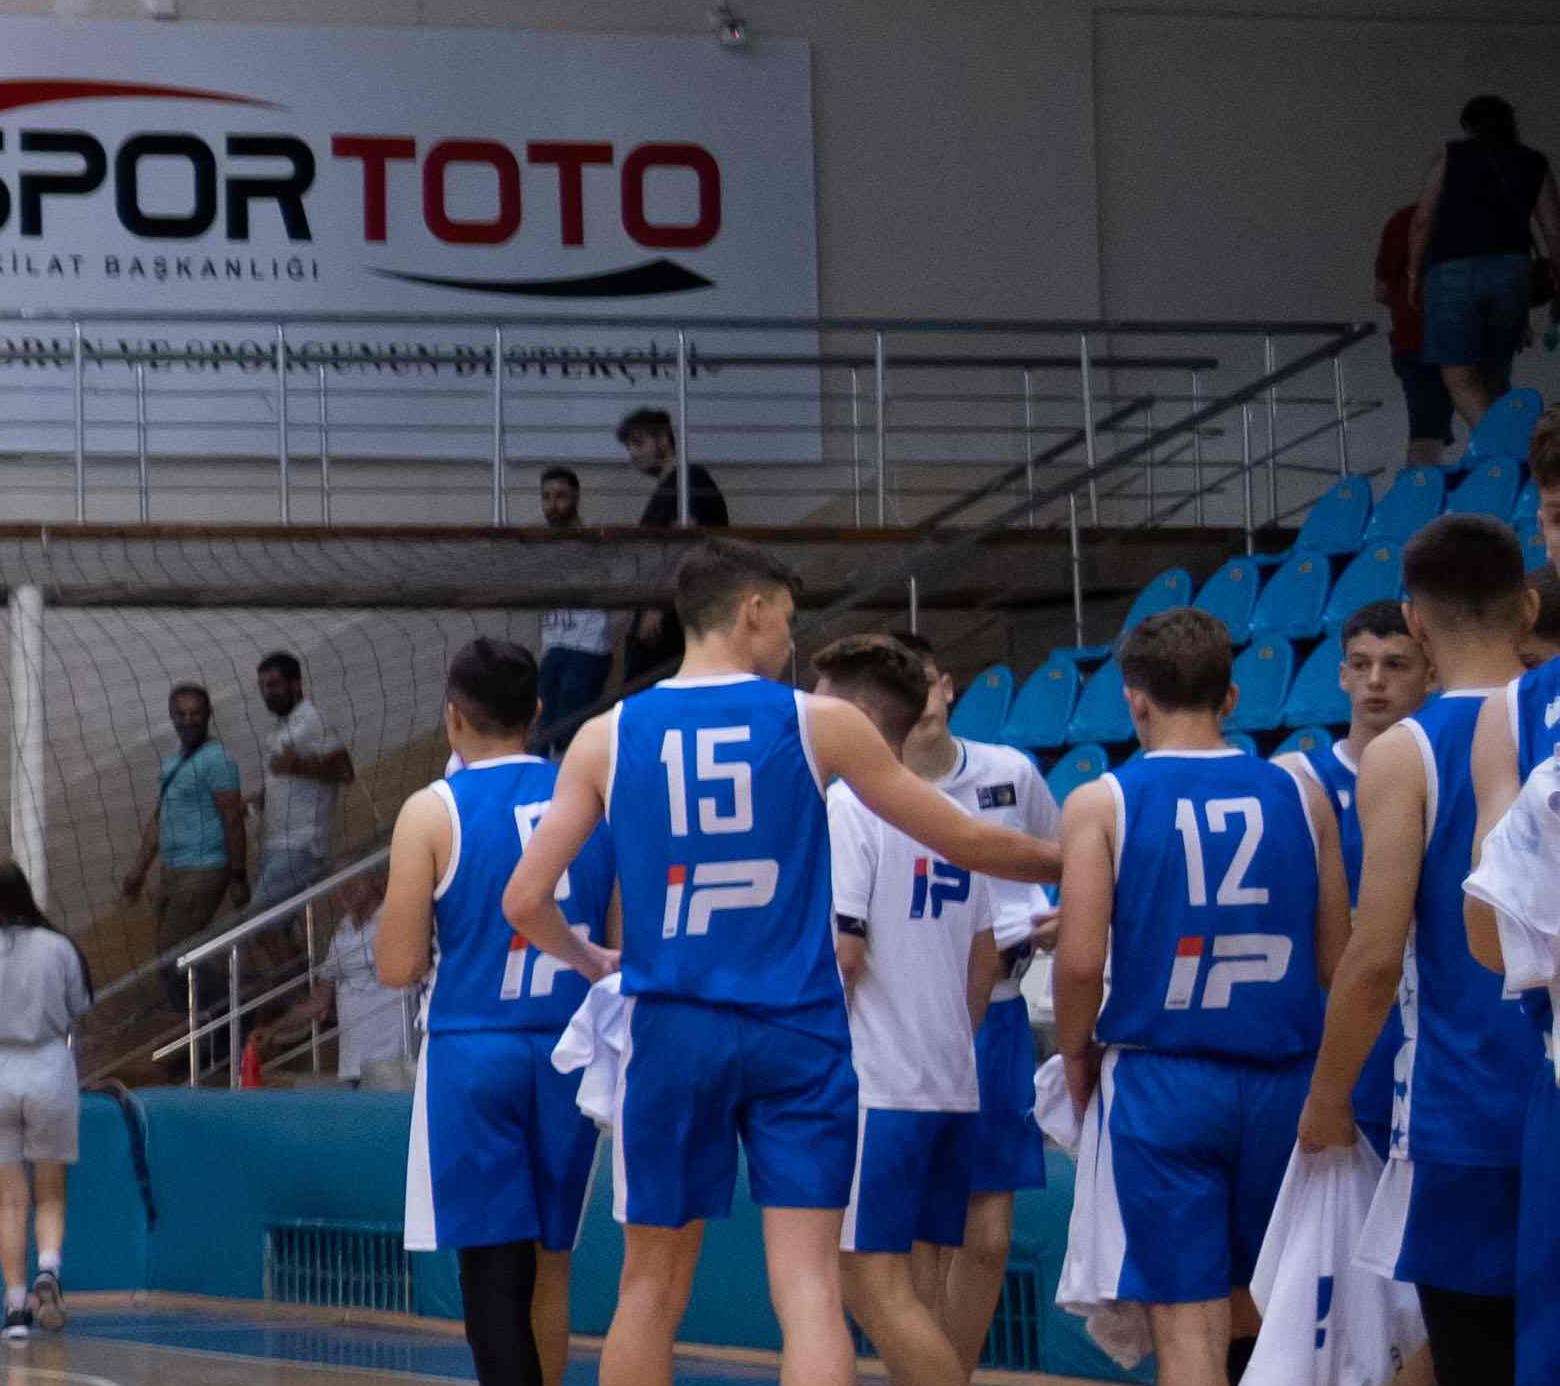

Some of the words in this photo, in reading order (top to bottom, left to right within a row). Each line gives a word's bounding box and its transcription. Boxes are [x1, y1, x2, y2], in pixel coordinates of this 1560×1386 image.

[330, 135, 722, 250] TOTO
[660, 725, 753, 838] 15
[1176, 796, 1269, 907] 12
